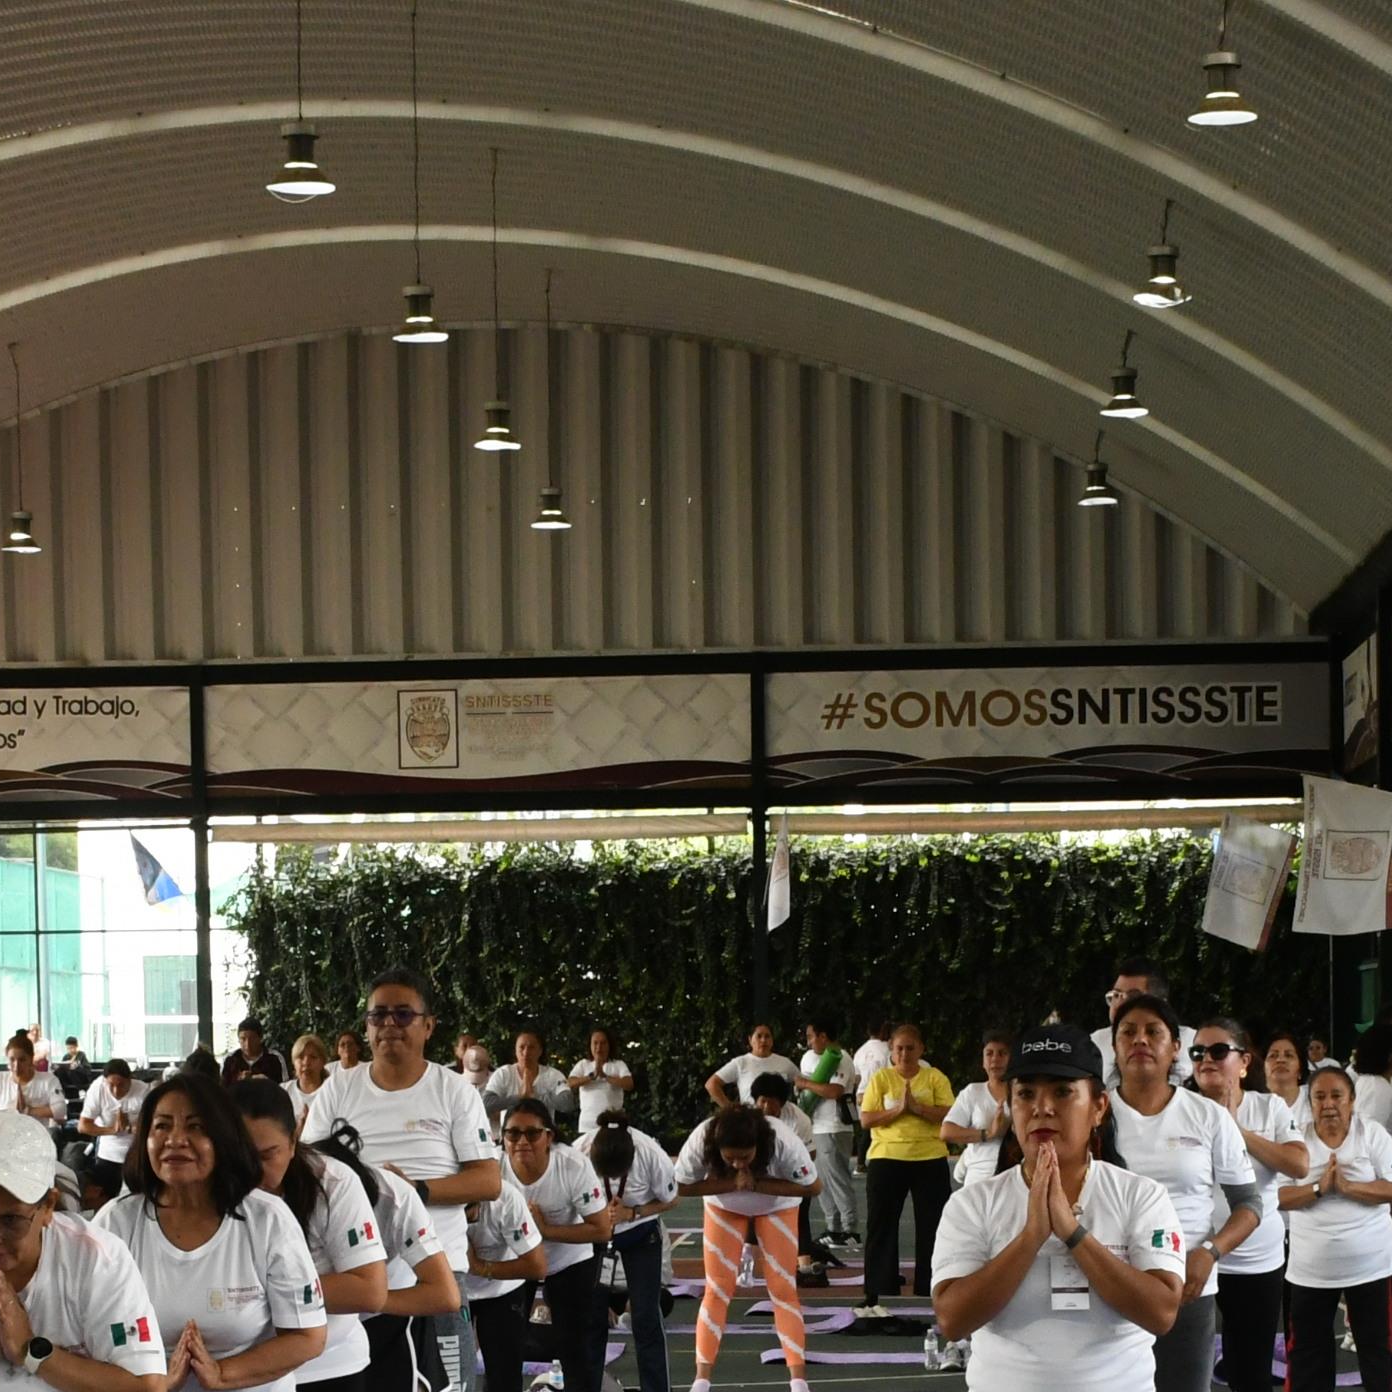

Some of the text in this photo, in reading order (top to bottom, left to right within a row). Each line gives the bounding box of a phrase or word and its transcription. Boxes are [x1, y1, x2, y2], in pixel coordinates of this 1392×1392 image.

[33, 699, 48, 720] y
[52, 695, 141, 720] Trabajo,
[464, 694, 554, 709] SNTISSSTE
[820, 685, 1279, 731] #SOMOSSNTISSSTE
[1021, 1038, 1072, 1054] bebe
